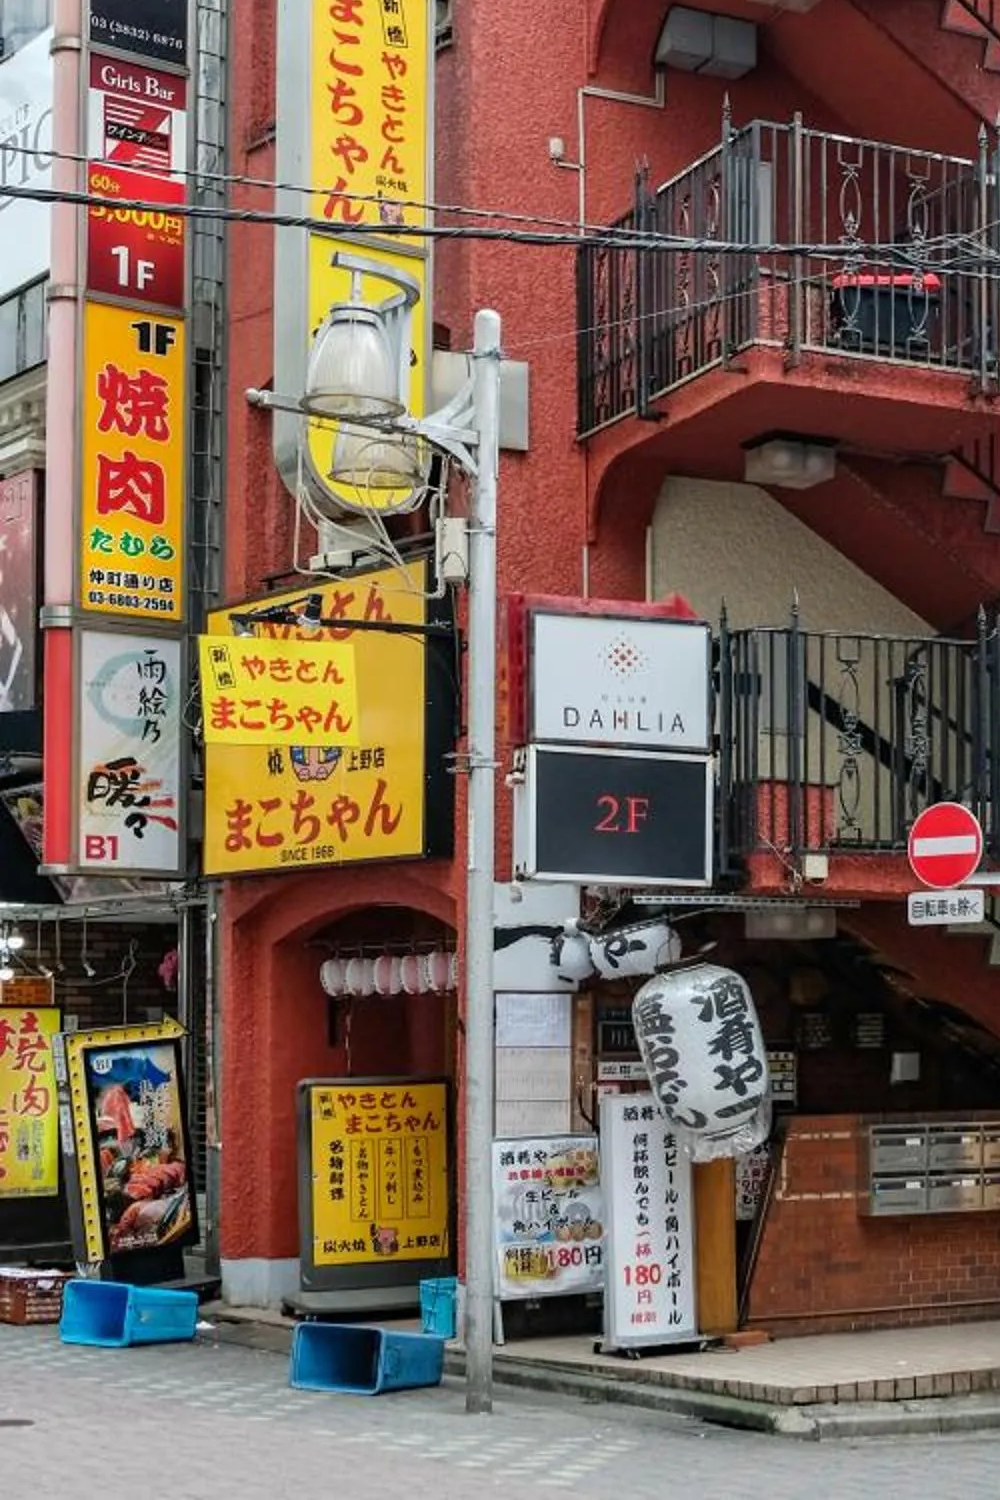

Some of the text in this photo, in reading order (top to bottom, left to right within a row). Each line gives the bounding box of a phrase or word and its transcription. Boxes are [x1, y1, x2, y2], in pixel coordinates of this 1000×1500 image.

[101, 65, 176, 101] Girls Bar
[380, 51, 408, 175] やきとん
[111, 245, 155, 290] 1F
[132, 321, 176, 355] 1F
[97, 363, 169, 524] 焼肉
[90, 527, 174, 560] たむら
[89, 568, 174, 593] 仲町通り店
[240, 655, 345, 684] やきとん
[210, 696, 352, 734] まこちゃん
[563, 706, 686, 733] DAHLIA
[347, 747, 385, 773] 上野店
[225, 778, 403, 853] まこちゃん
[595, 795, 649, 834] 2F
[85, 834, 119, 861] B1
[280, 847, 308, 863] SINCE
[911, 897, 980, 918] 自転車を除く
[337, 1091, 417, 1110] やきとん
[345, 1112, 441, 1135] まこちゃん
[624, 1264, 662, 1286] 180
